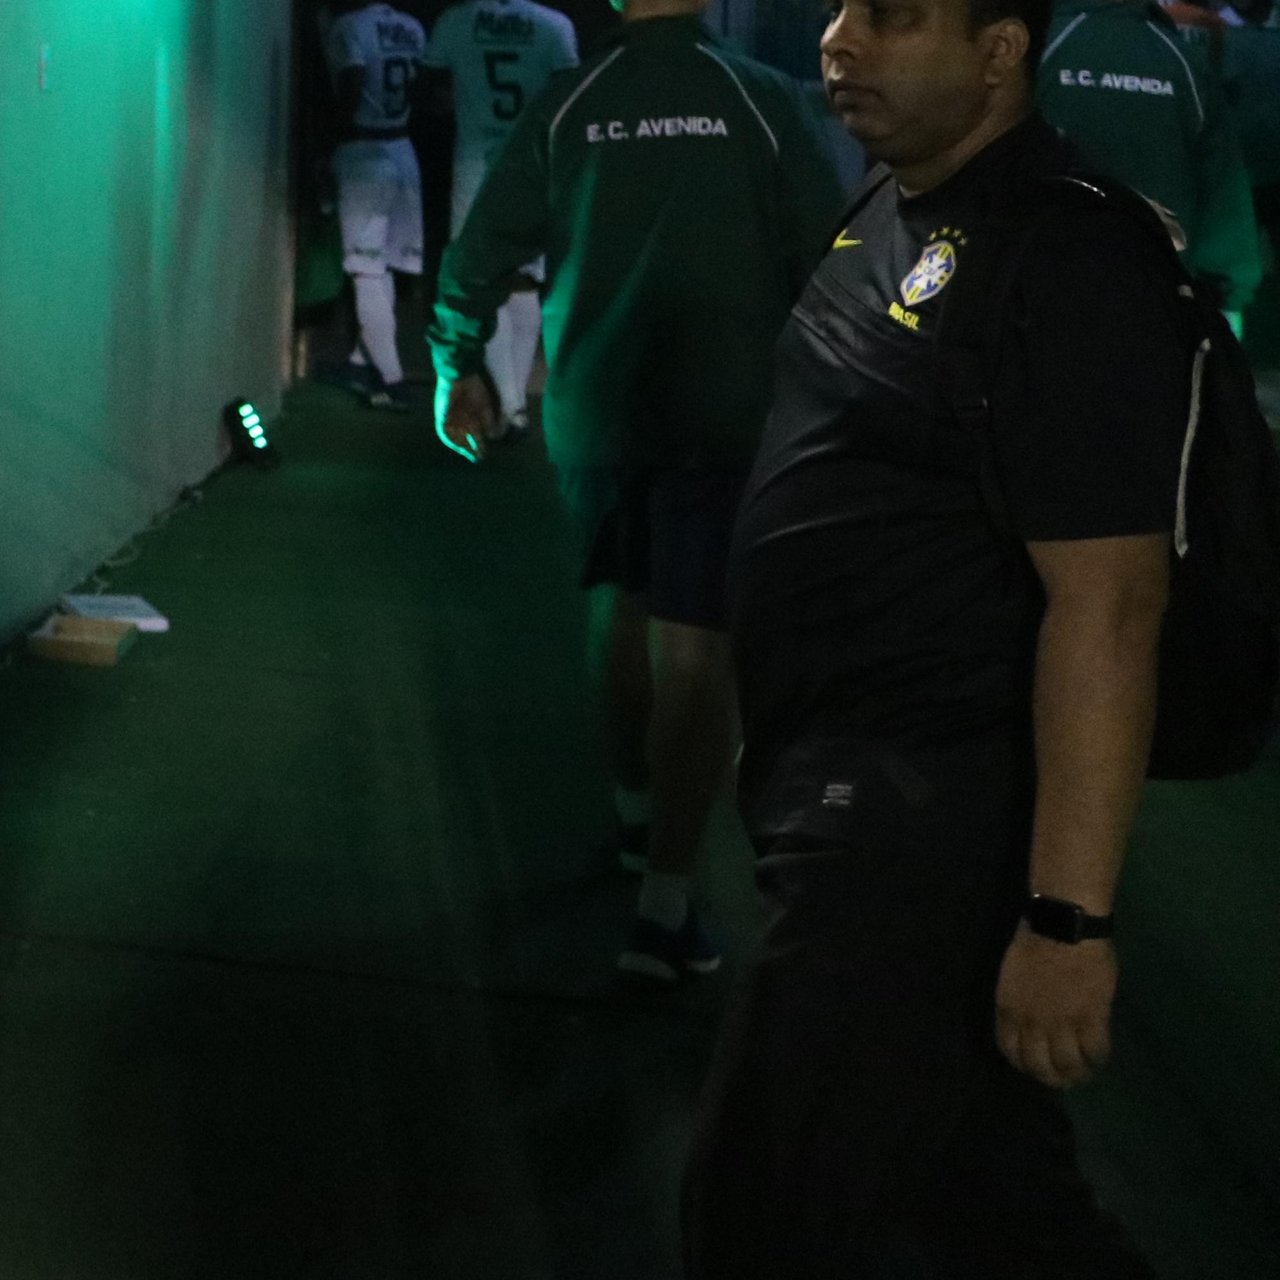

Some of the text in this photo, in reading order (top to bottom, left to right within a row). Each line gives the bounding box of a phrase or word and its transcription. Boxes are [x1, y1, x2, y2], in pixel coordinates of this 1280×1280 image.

[484, 50, 524, 120] 5
[1100, 72, 1174, 96] AVENIDA
[635, 116, 729, 139] AVENIDA
